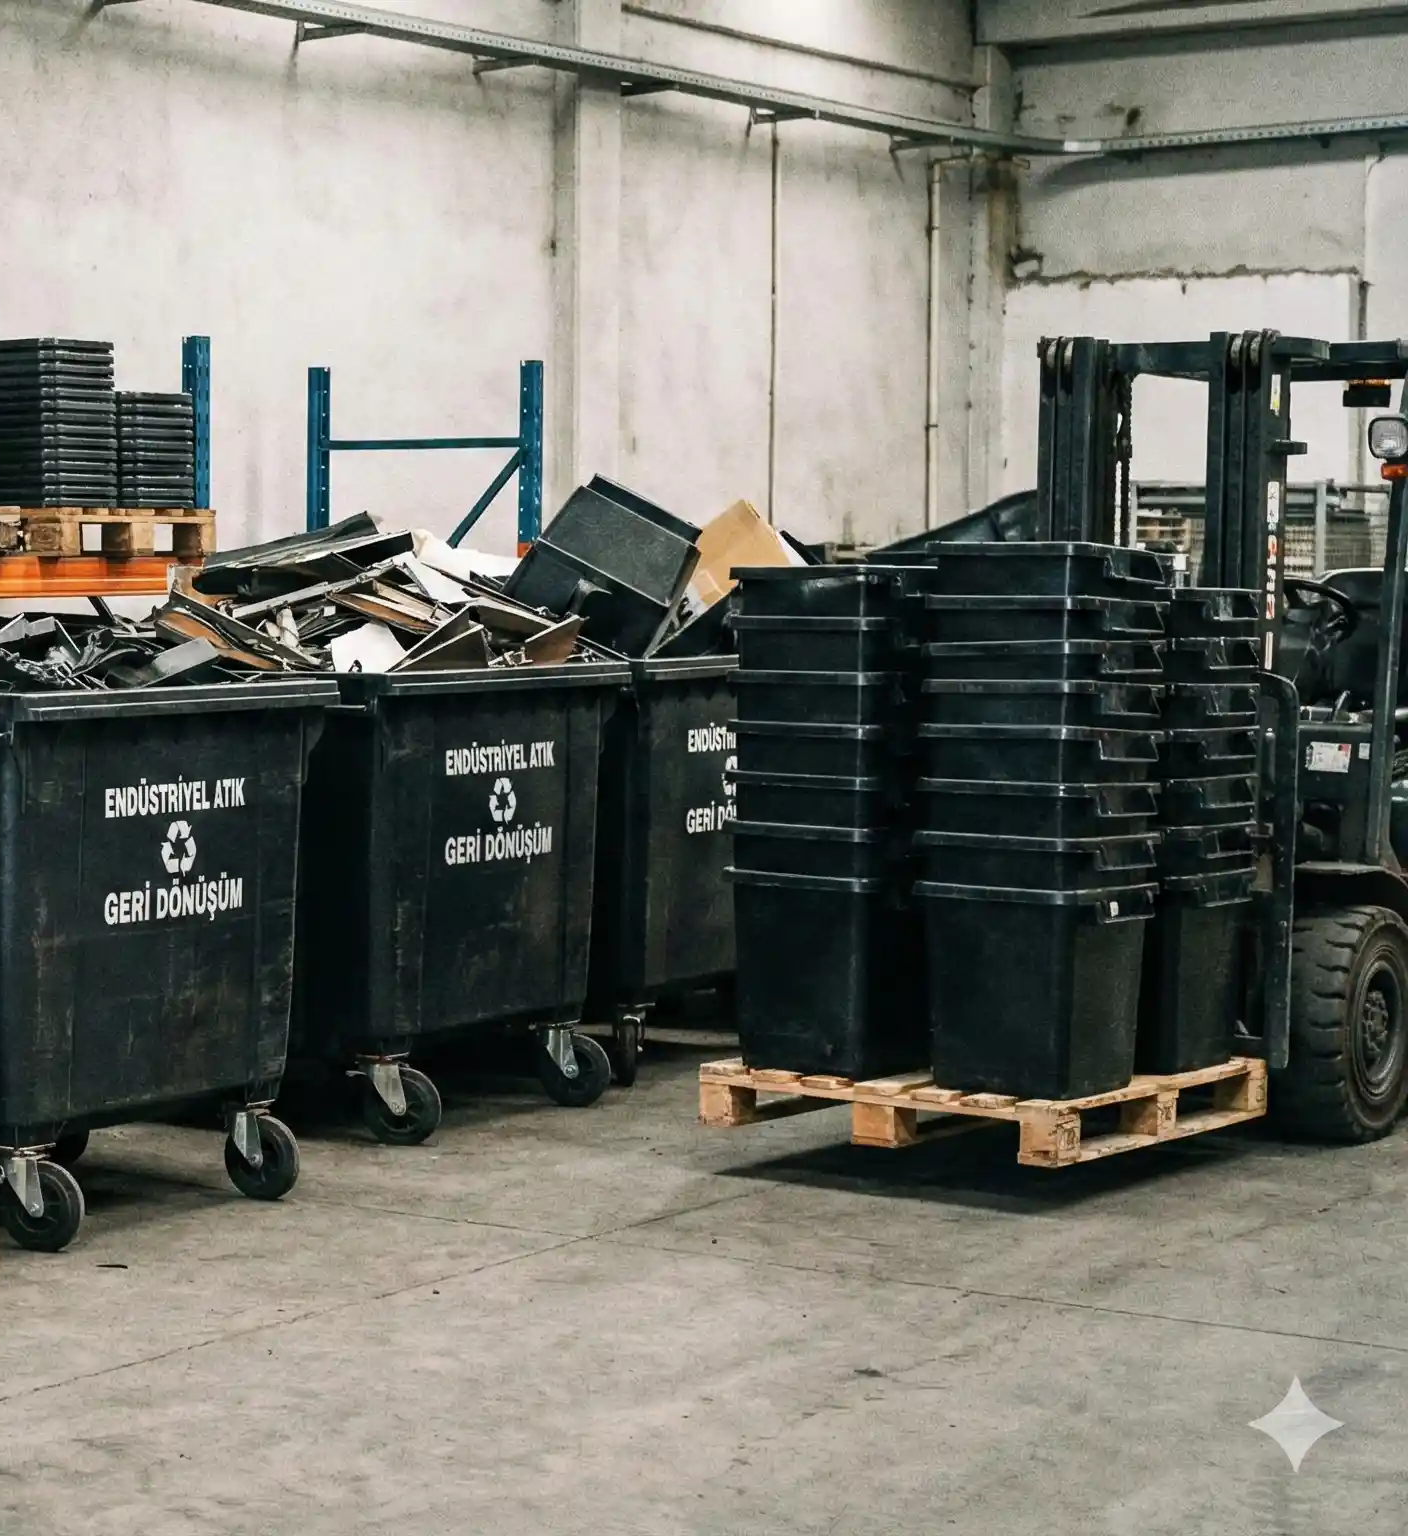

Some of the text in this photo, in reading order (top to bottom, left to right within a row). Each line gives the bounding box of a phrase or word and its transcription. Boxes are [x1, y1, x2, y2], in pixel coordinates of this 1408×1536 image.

[445, 738, 555, 775] ENDÜSTRİYEL ATIK
[105, 774, 246, 818] ENDÜSTRİYEL ATIK
[686, 800, 715, 834] GERİ
[444, 821, 552, 865] GERİ DÖNÜŞÜM
[104, 872, 243, 925] GERİ DÖNÜŞÜM
